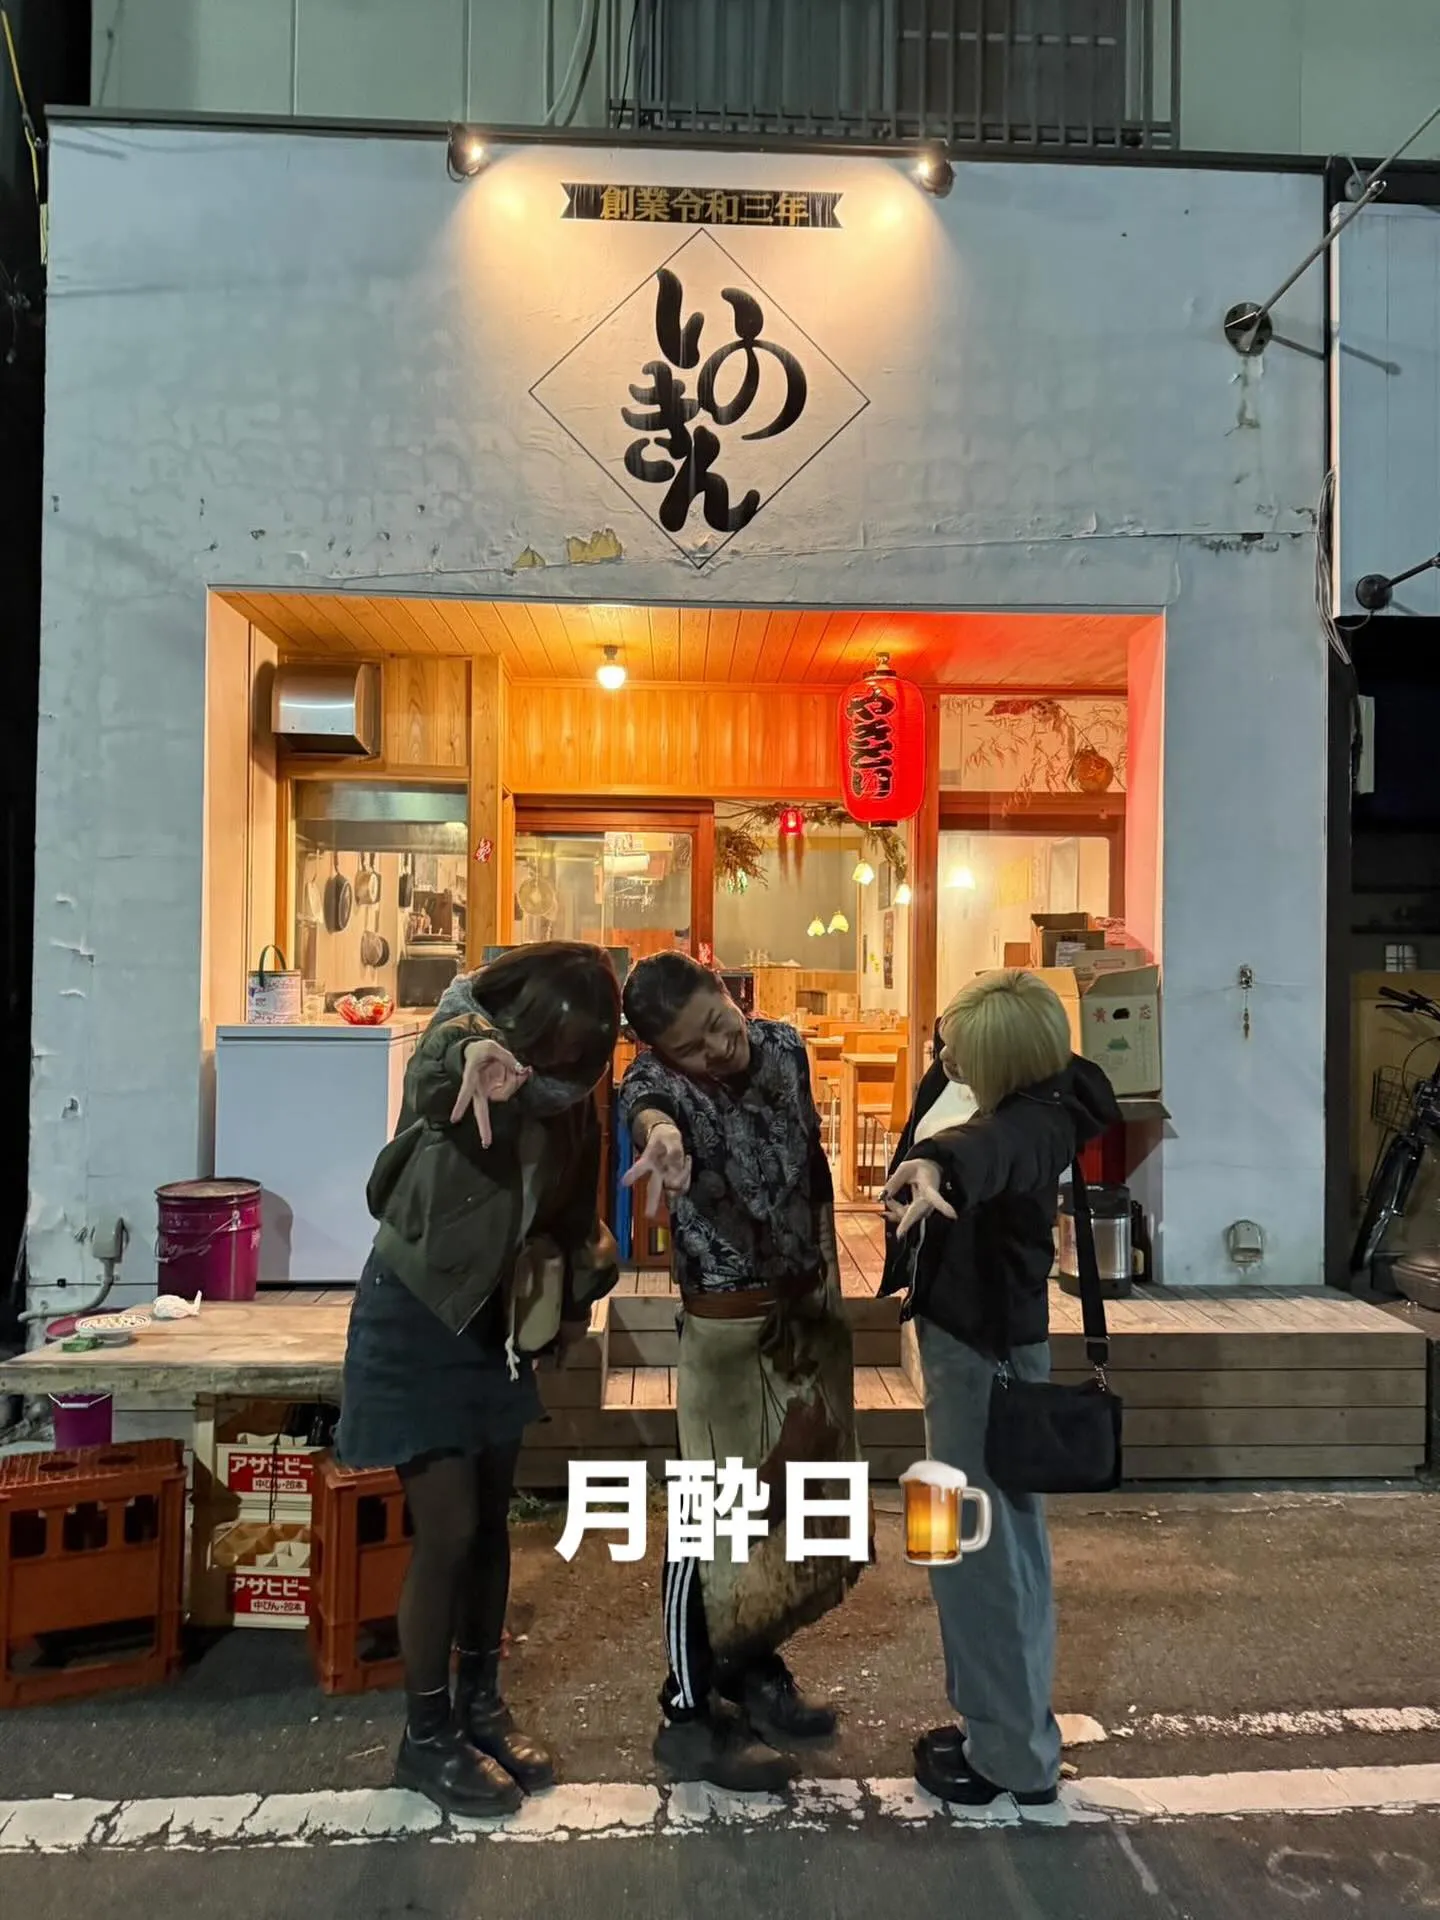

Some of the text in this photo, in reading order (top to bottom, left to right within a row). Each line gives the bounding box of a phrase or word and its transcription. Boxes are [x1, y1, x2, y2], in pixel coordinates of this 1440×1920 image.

[600, 185, 809, 226] 創業令和三年
[230, 1455, 313, 1476] アサヒビー
